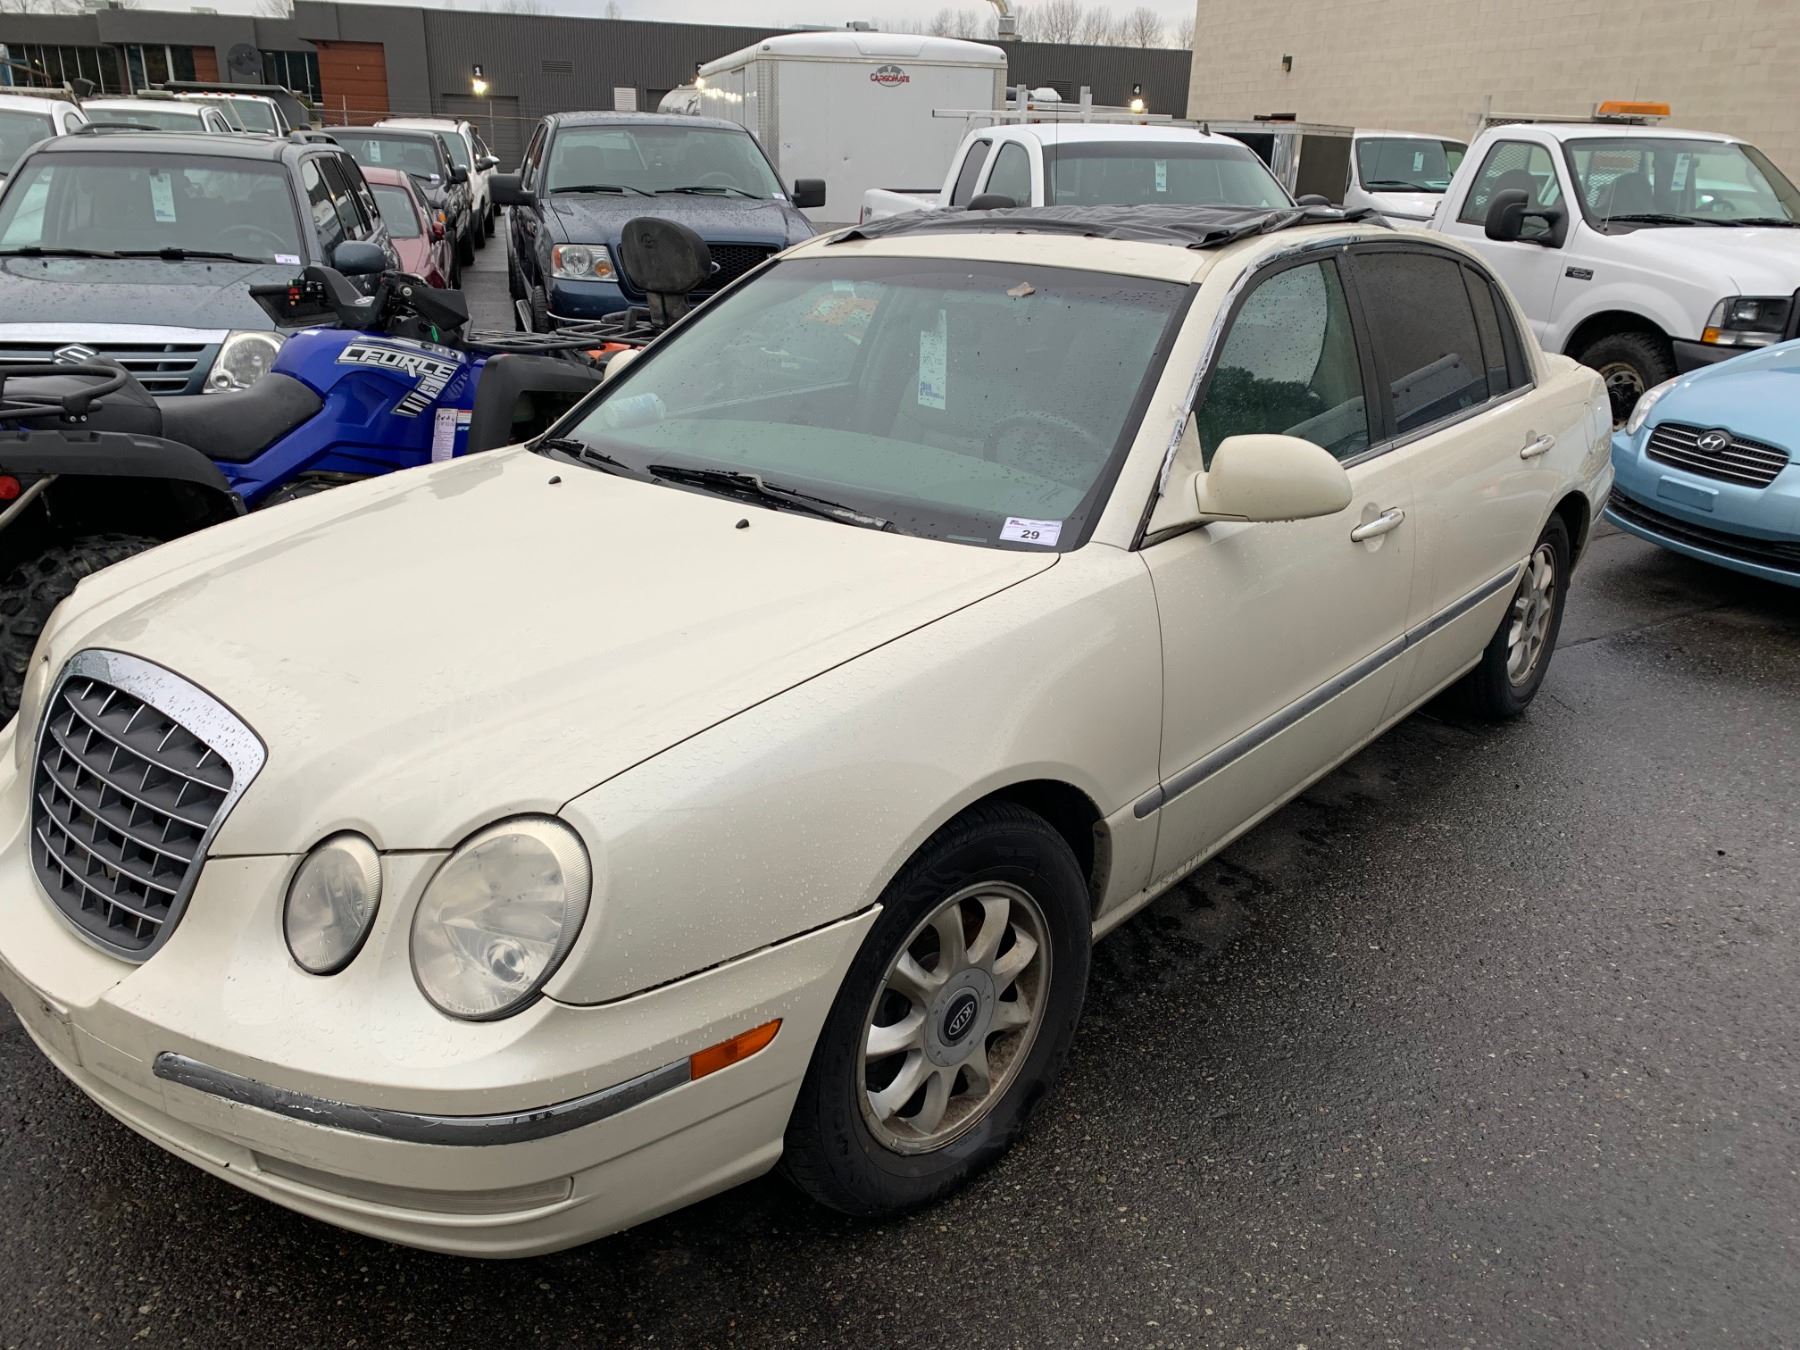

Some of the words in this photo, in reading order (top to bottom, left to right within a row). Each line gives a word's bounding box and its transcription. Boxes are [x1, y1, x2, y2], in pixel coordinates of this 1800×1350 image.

[475, 66, 481, 76] 1
[1134, 85, 1140, 95] 4
[337, 345, 458, 379] CFORCE
[1021, 529, 1040, 540] 29
[952, 1006, 971, 1030] KIA
